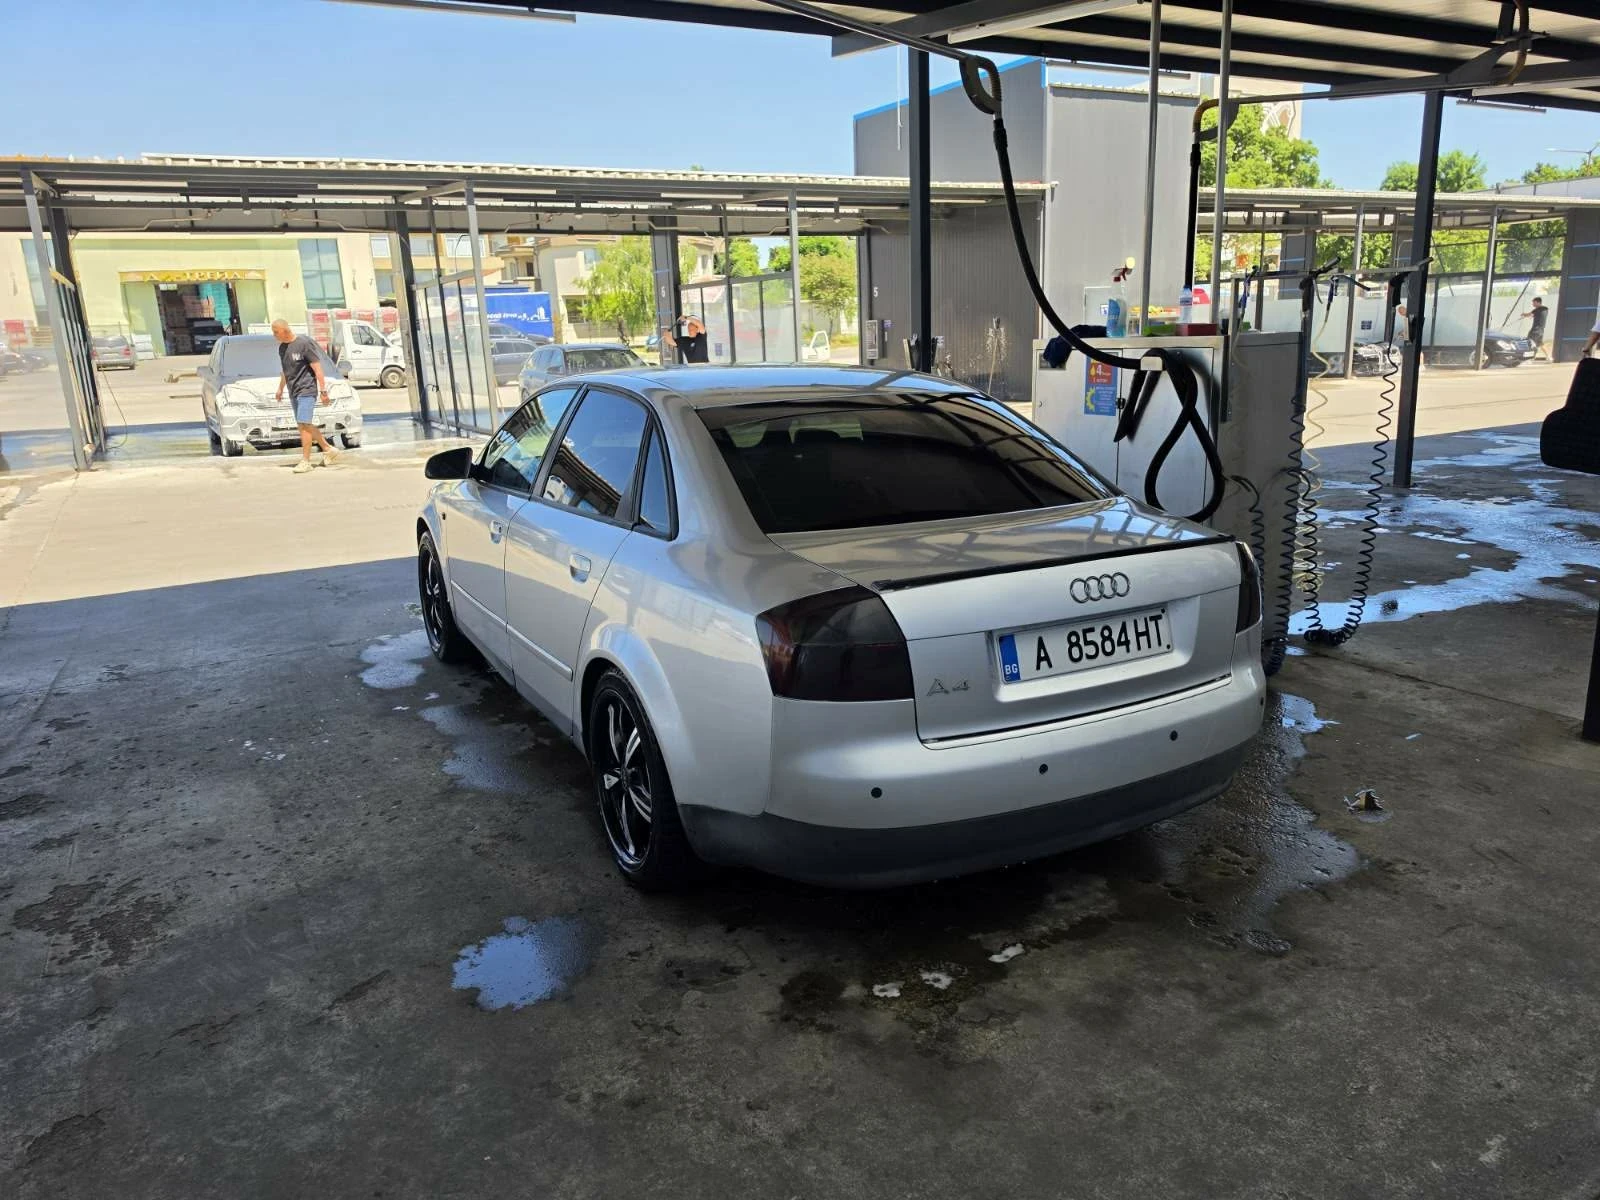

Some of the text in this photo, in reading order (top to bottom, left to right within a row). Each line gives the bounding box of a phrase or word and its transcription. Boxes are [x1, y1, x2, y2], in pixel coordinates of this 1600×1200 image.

[873, 286, 878, 298] 5
[1035, 636, 1053, 671] A
[1005, 663, 1019, 675] BG
